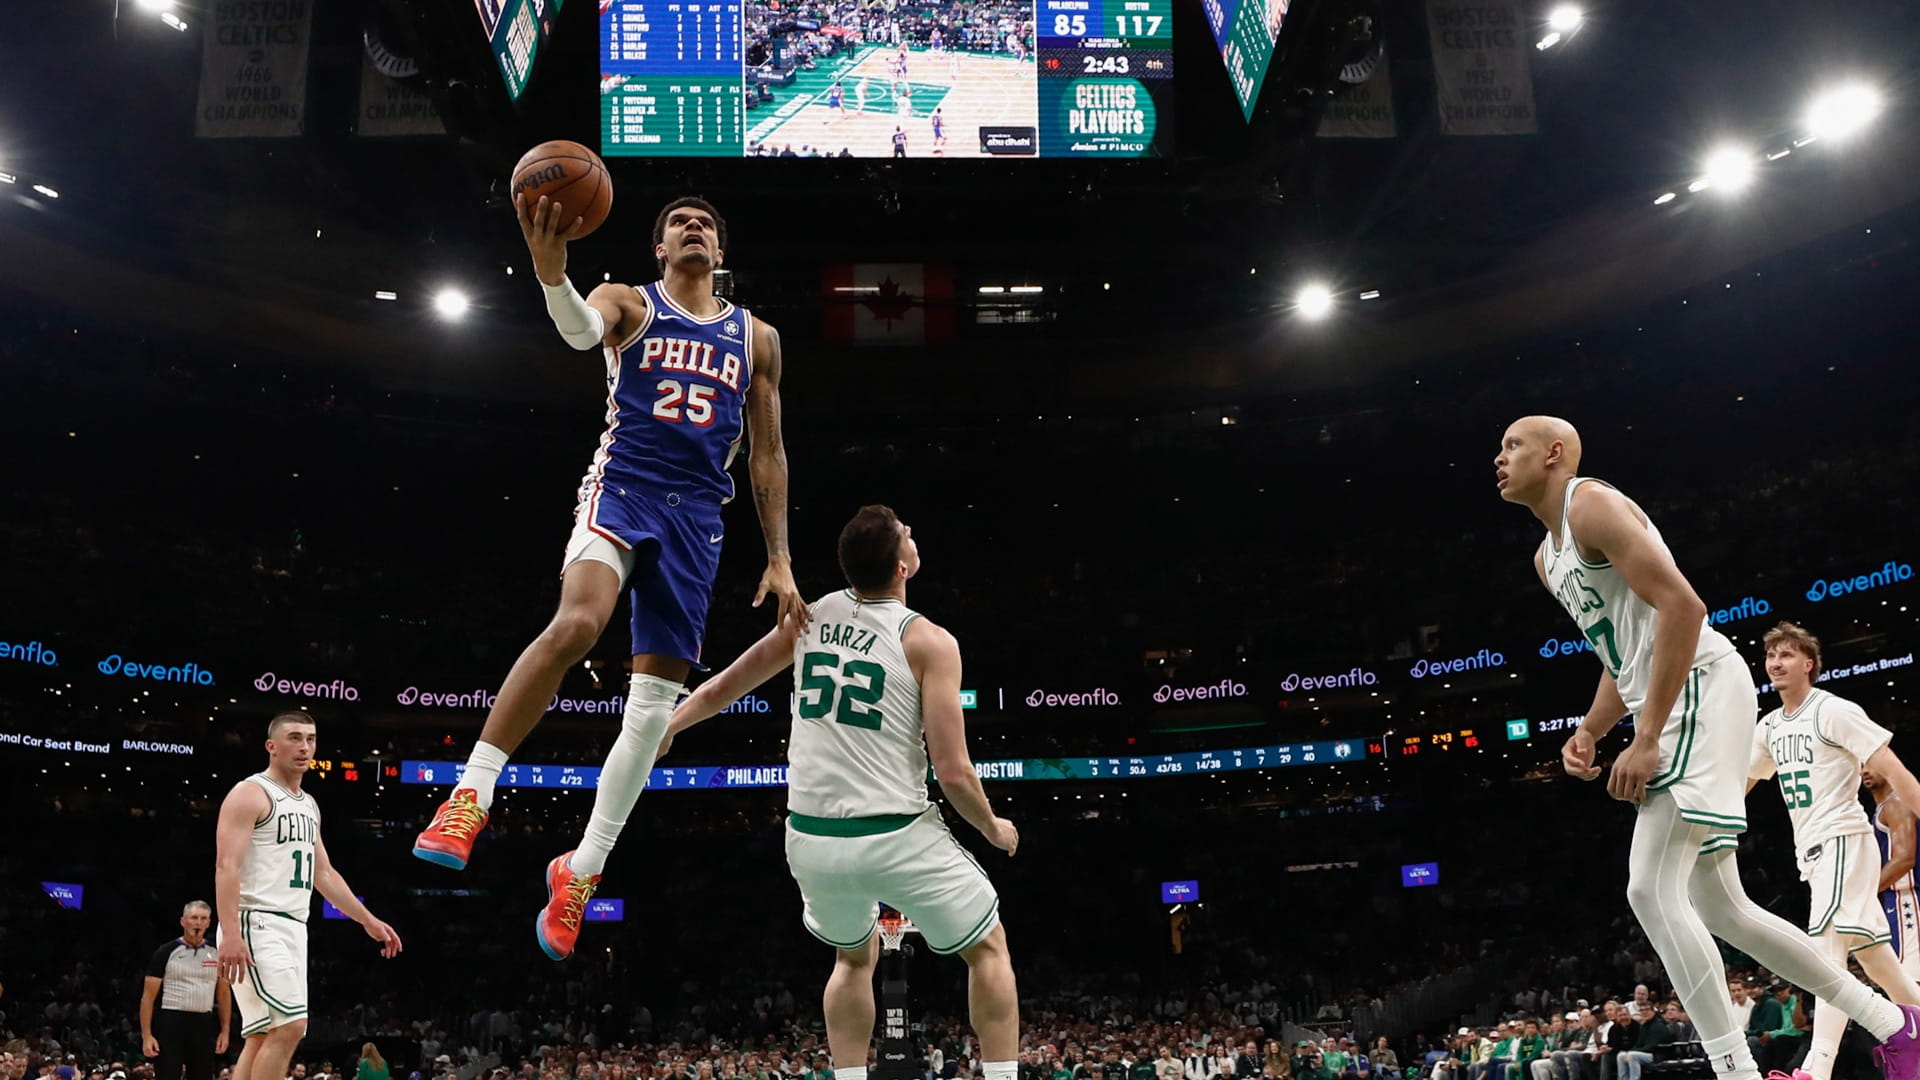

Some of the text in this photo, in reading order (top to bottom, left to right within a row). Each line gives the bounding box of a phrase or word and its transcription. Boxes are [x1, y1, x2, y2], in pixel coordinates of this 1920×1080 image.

[217, 24, 297, 45] CELTICS
[1054, 14, 1087, 36] 85
[1115, 15, 1163, 36] 117
[1442, 28, 1515, 48] CELTICS
[236, 68, 272, 82] 1966
[1045, 55, 1164, 74] 16 2:43 4th
[226, 86, 281, 101] WORLD
[1076, 85, 1136, 109] CELTICS
[204, 104, 298, 121] CHAMPIONS
[1069, 110, 1144, 134] PLAYOFFS
[1109, 143, 1144, 151] PIMCO
[638, 337, 743, 392] PHILA
[652, 379, 718, 427] 25
[1828, 561, 1913, 597] evenflo
[1707, 597, 1770, 626] venflo
[820, 623, 878, 656] GARZA
[1429, 649, 1504, 676] evenflo
[1831, 653, 1913, 680] Car Seat Brand
[123, 662, 213, 685] evenflo
[1301, 667, 1376, 690] evenflo
[277, 679, 358, 701] evenflo
[799, 651, 886, 731] 52
[1045, 687, 1119, 707] evenflo
[1173, 679, 1246, 701] evenflo
[559, 695, 627, 714] evenfl
[1509, 723, 1527, 737] TD
[1539, 718, 1564, 732] 3:27
[22, 735, 43, 747] Car
[44, 738, 72, 751] Seat
[74, 741, 110, 754] Brand
[122, 739, 194, 755] BARLOW.RON
[1369, 743, 1382, 753] 16
[1432, 732, 1452, 744] 2:43
[1770, 734, 1814, 766] CELTICS
[385, 766, 398, 777] 16
[976, 762, 1023, 778] BOSTON
[1092, 753, 1316, 776] 3 4 50.6 43/85 14/38 8 7 29 40
[510, 774, 695, 786] 3 14 4/22 3 4
[1777, 769, 1813, 810] 55
[289, 850, 313, 891] 11
